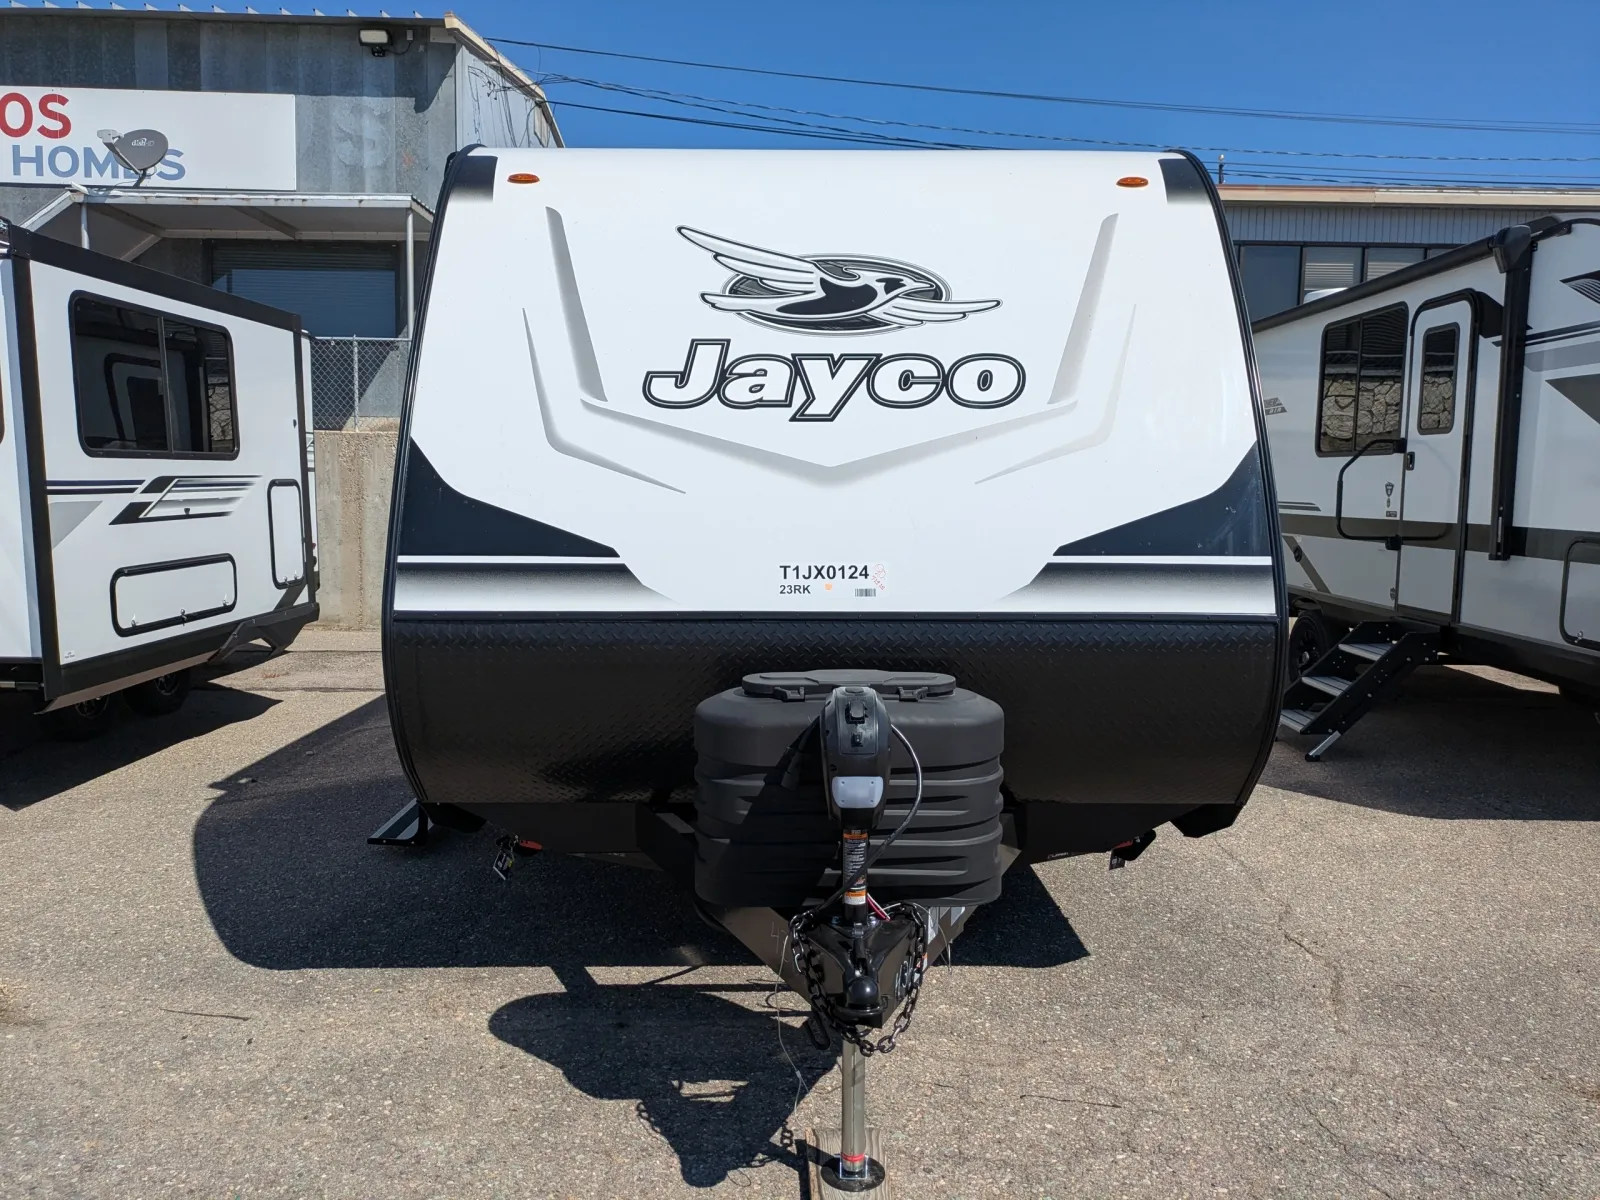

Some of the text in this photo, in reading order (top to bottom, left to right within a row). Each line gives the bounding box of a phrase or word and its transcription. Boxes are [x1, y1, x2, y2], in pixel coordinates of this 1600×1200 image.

[642, 338, 1026, 422] Jayco
[779, 565, 869, 580] T1JX0124
[779, 584, 811, 595] 23RK
